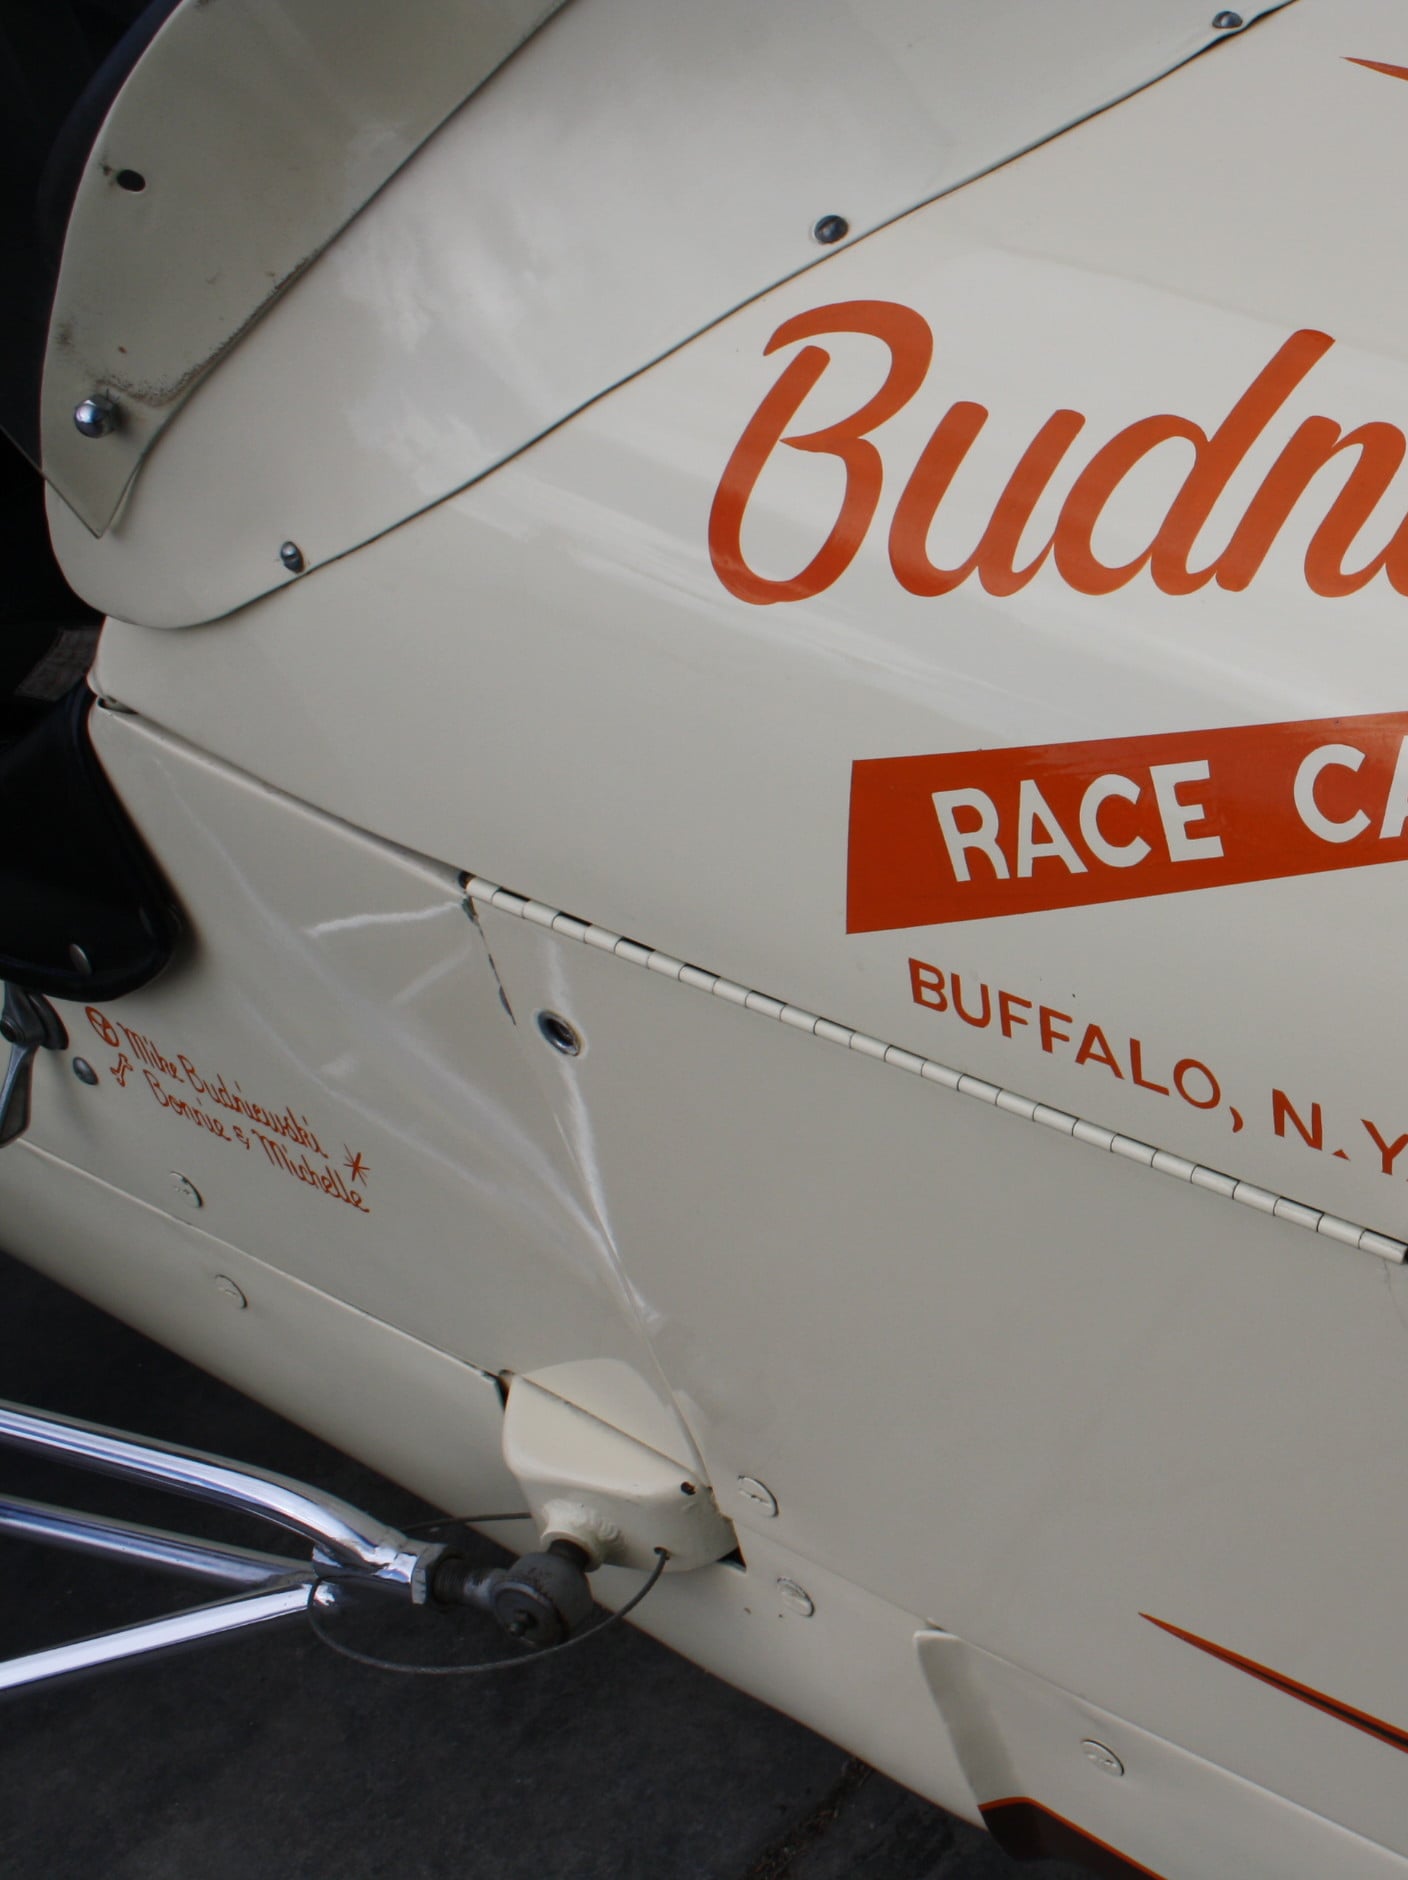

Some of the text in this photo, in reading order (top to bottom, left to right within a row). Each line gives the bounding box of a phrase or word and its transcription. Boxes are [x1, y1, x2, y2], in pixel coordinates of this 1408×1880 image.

[931, 759, 1225, 883] RACE
[116, 1021, 329, 1159] Mike Budniewski
[909, 958, 1243, 1132] BUFFALO,
[143, 1068, 232, 1142] Bonnie
[251, 1129, 370, 1212] Michelle
